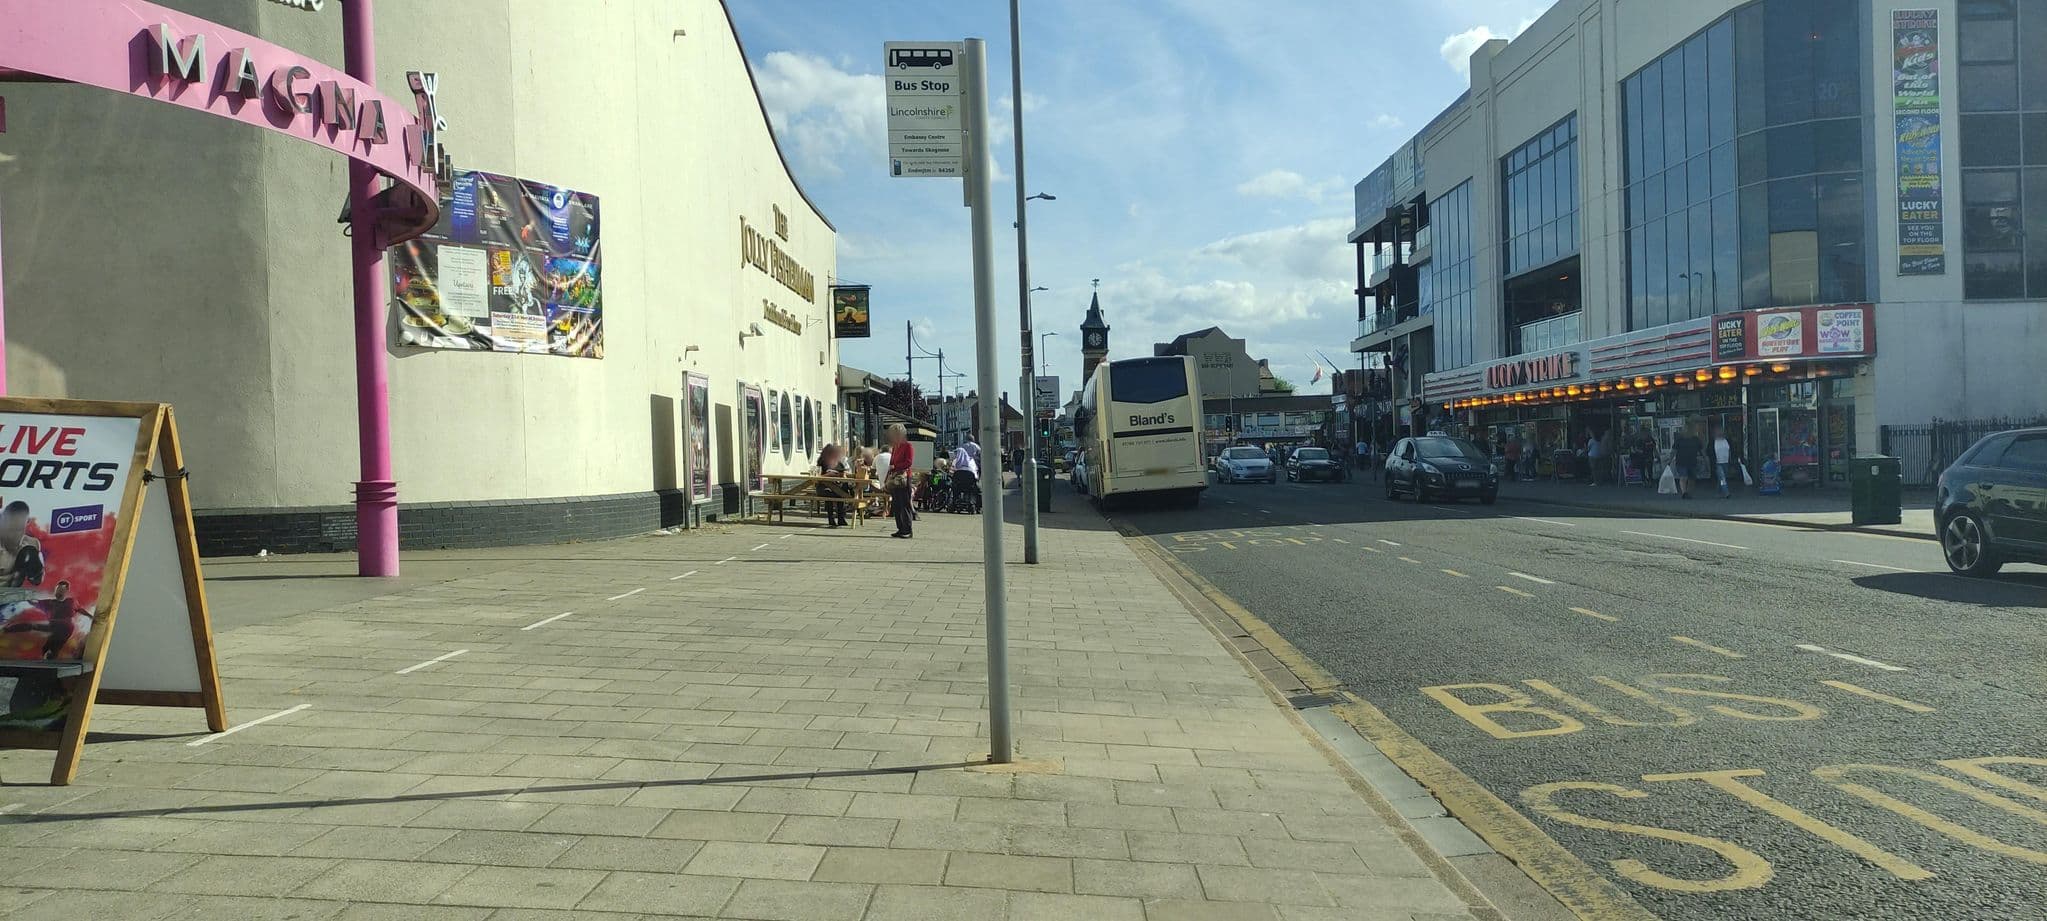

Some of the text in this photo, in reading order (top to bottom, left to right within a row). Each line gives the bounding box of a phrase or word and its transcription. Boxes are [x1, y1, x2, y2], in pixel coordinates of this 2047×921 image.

[149, 23, 389, 144] MAGNA
[894, 80, 950, 93] Bus Stop
[890, 105, 947, 117] Lincolnshire
[1901, 200, 1939, 210] LUCKY
[1902, 211, 1939, 220] EATER
[772, 203, 788, 242] THE
[739, 214, 815, 305] JOLLY FISHERMAN
[492, 286, 513, 296] FREE
[1718, 319, 1742, 330] LUCKY
[1718, 329, 1742, 338] EATER
[1761, 339, 1799, 347] ADVENTURE
[1486, 352, 1576, 388] LUCKY STRIKE
[1129, 412, 1175, 427] Bland's
[60, 513, 98, 524] BT SPORT
[1172, 530, 1283, 543] BUS
[1166, 536, 1323, 553] STOP
[1419, 672, 1828, 739] BUS
